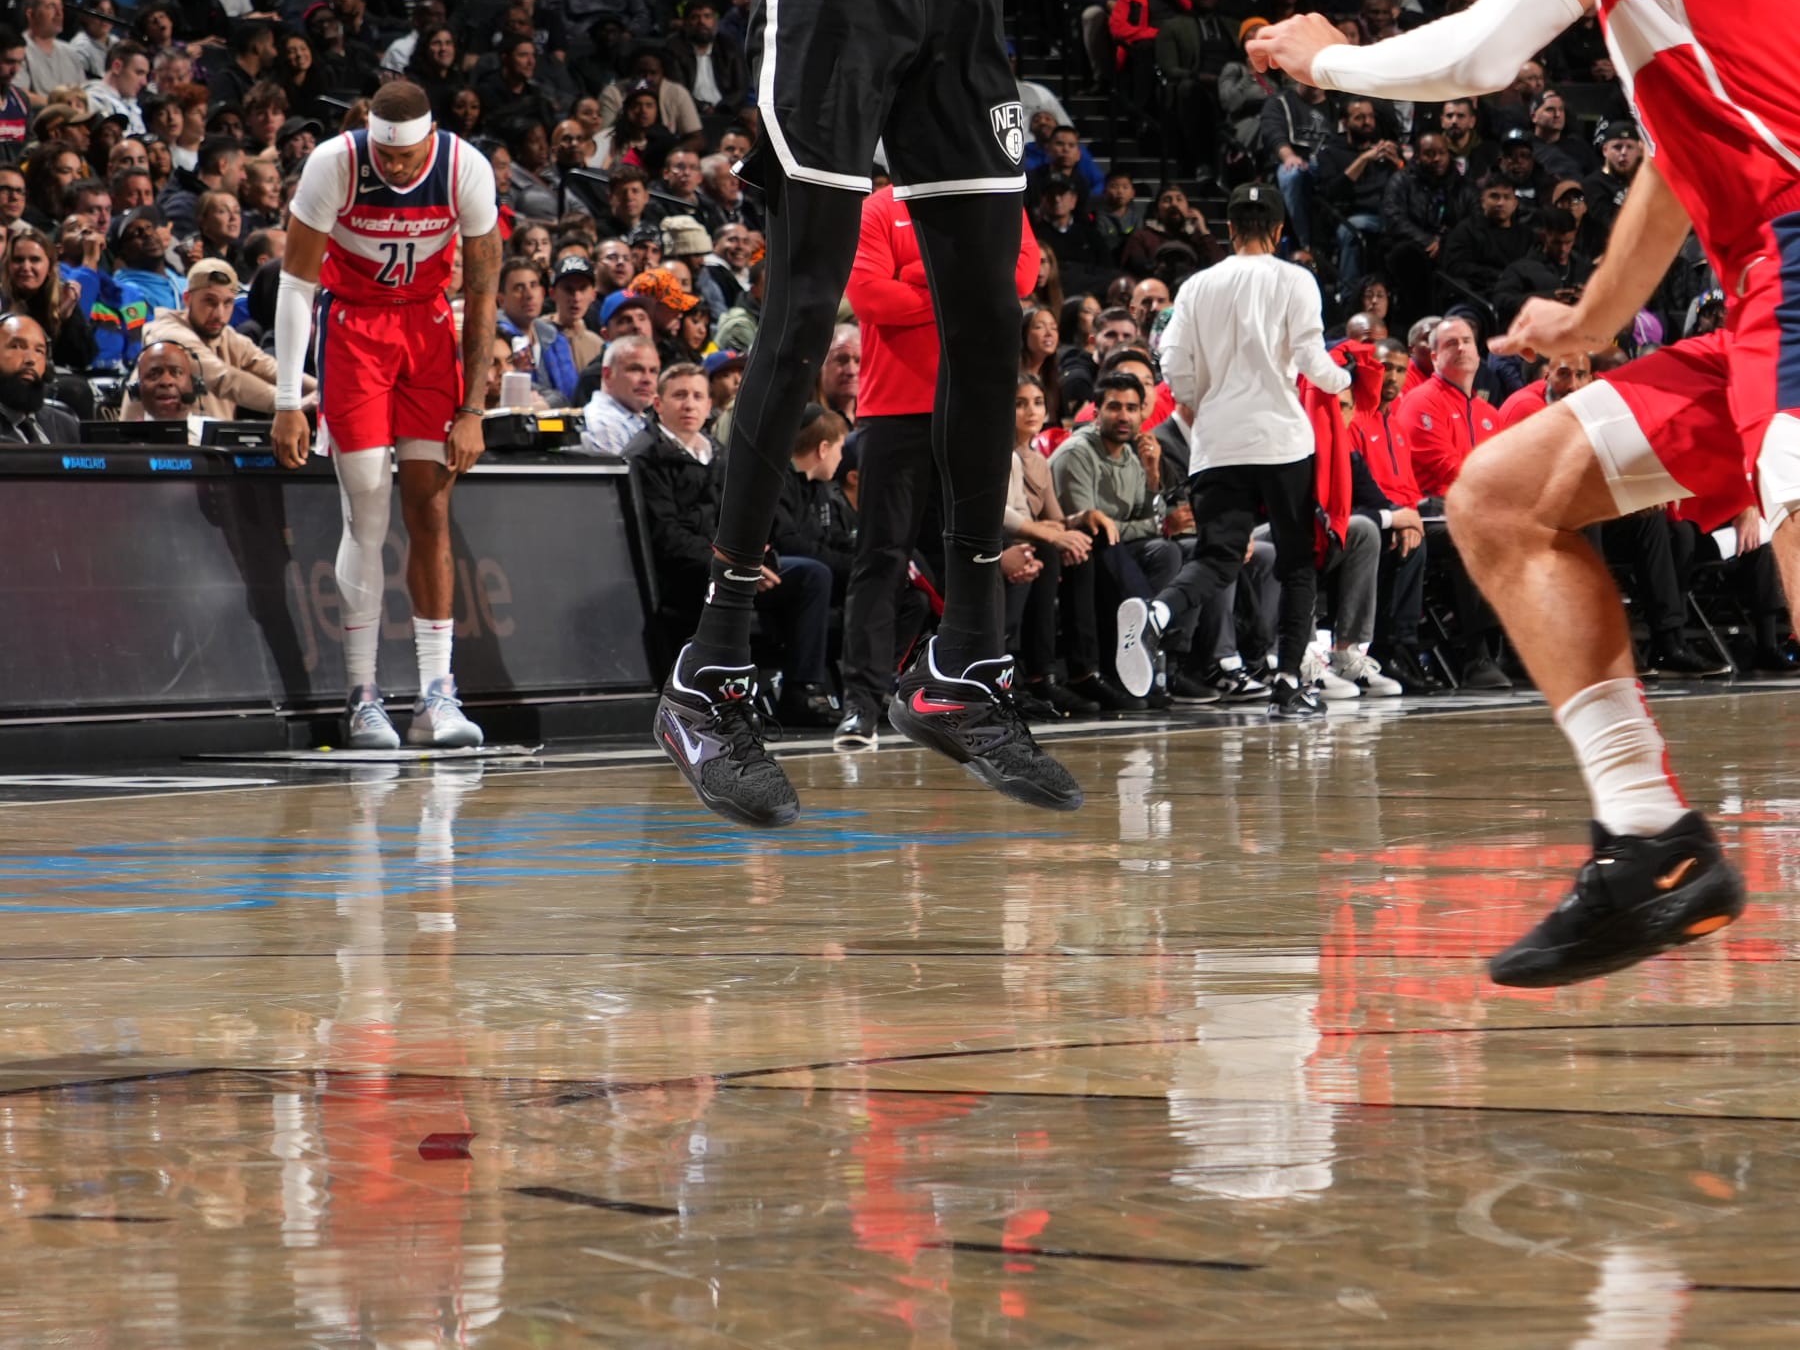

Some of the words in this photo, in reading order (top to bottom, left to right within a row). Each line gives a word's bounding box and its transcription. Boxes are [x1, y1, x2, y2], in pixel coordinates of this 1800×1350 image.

[994, 105, 1023, 132] NET
[361, 164, 370, 178] 6
[350, 213, 451, 237] washington
[373, 241, 417, 289] 21
